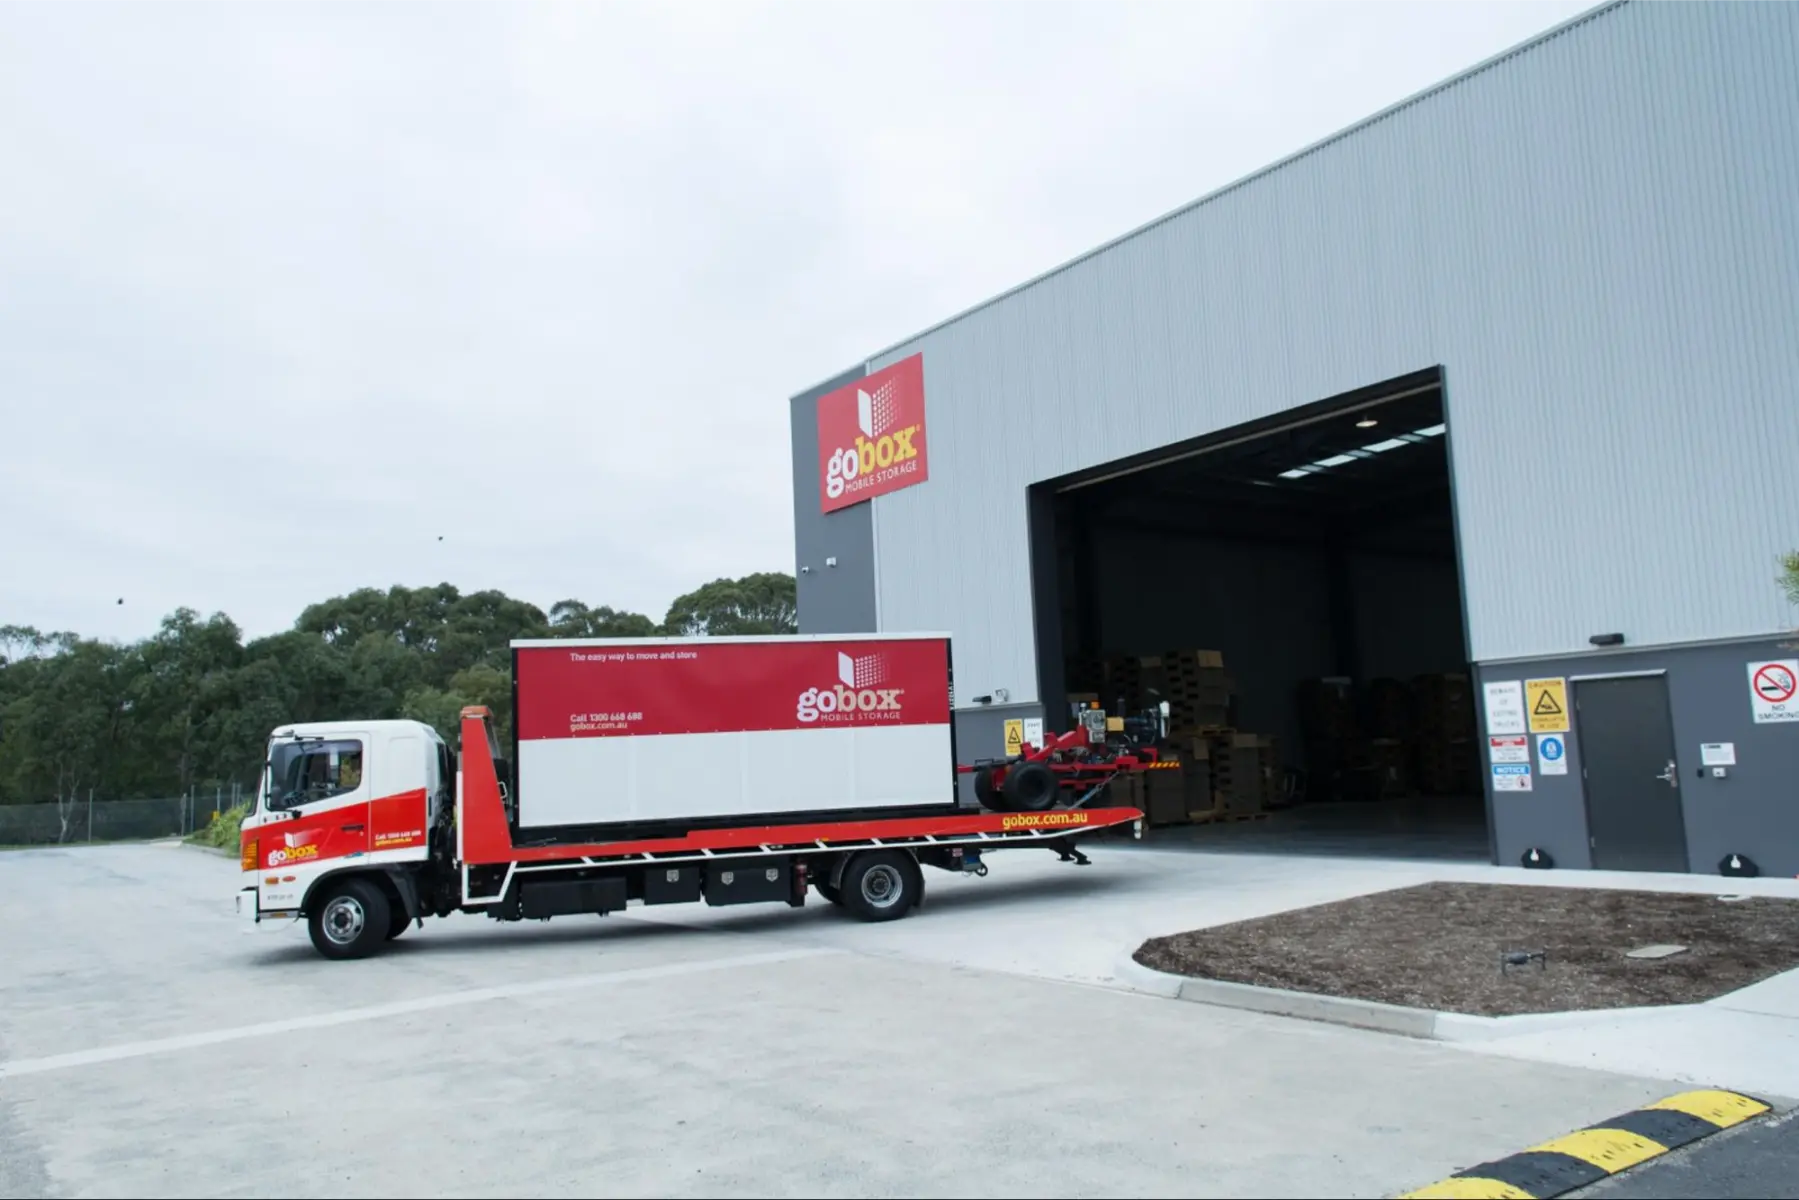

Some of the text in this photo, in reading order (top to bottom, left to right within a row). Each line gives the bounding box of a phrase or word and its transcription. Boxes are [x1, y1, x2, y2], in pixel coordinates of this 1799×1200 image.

[826, 425, 918, 499] gobox
[845, 461, 918, 494] MOBILE STORAGE
[570, 651, 698, 663] The easy way to move and store
[796, 684, 902, 722] gobox
[570, 714, 588, 722] Call
[821, 711, 901, 721] MOBILE STORAGE
[570, 722, 628, 732] gobox.com.au
[1002, 812, 1088, 830] gobox.com.au
[268, 844, 318, 867] gobox
